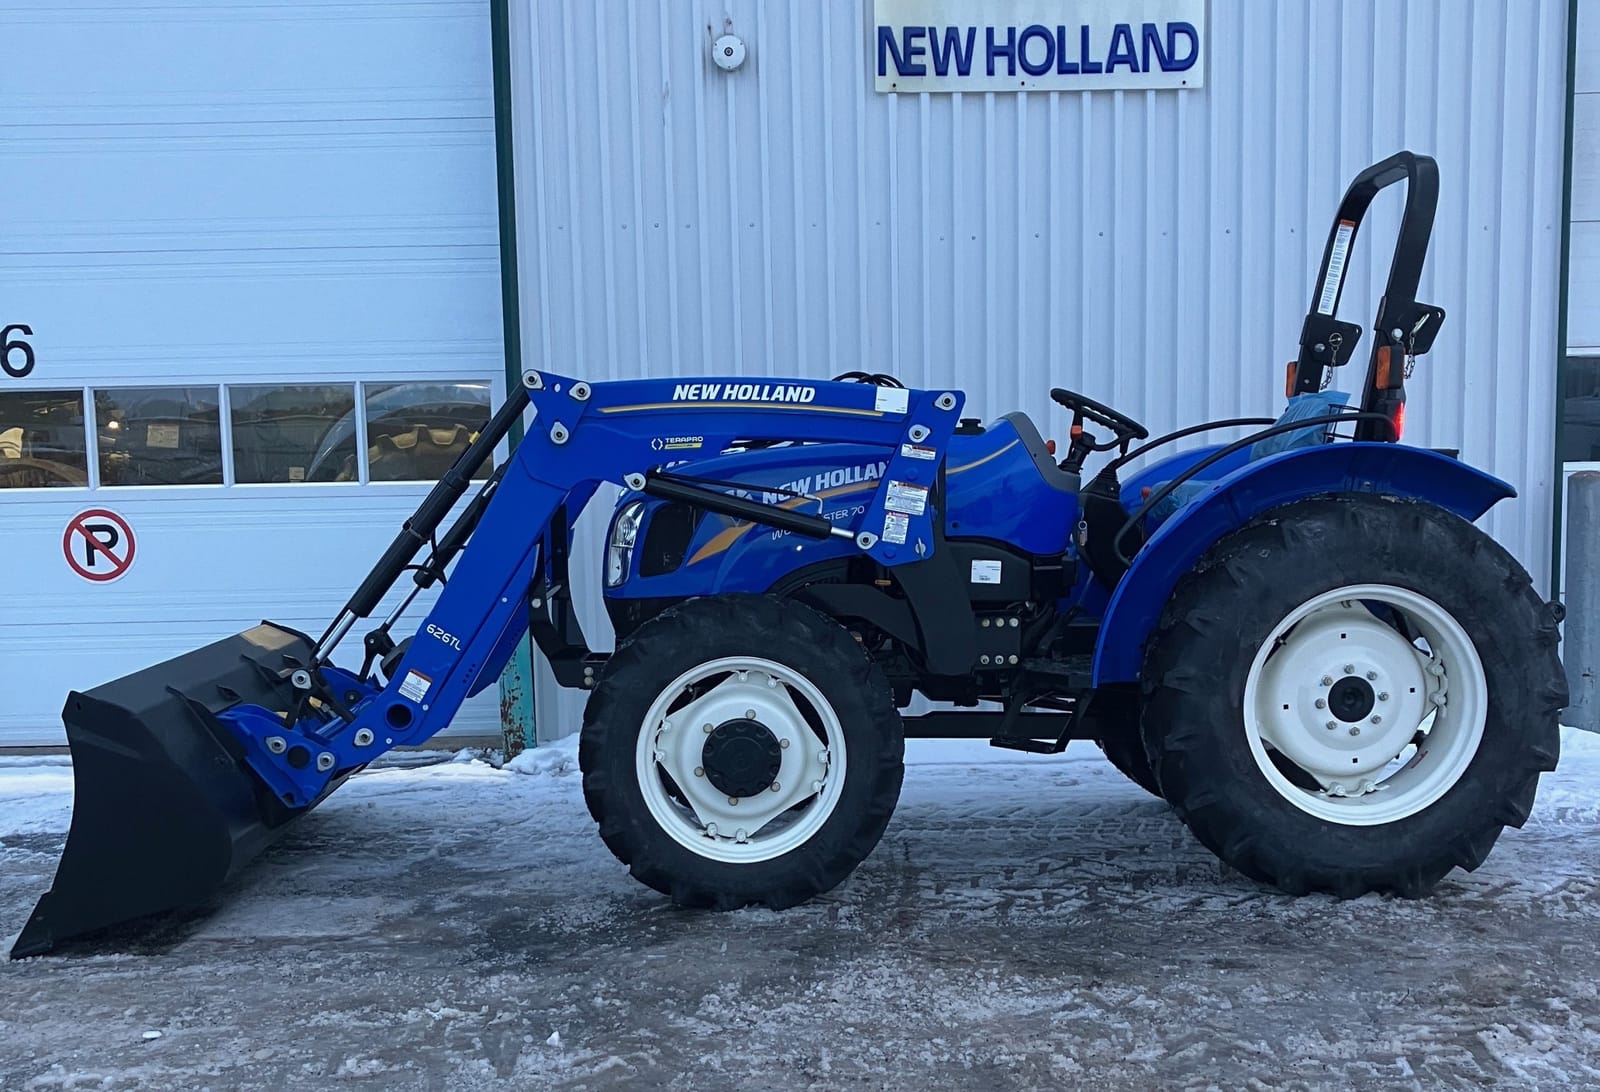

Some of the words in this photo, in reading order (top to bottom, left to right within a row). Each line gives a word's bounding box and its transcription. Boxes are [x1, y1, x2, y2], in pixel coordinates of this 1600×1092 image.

[877, 26, 977, 77] NEW
[985, 22, 1199, 77] HOLLAND
[0, 324, 35, 378] 6
[672, 384, 721, 401] NEW
[722, 384, 816, 403] HOLLAND
[664, 436, 704, 444] TERAPRO
[815, 460, 890, 492] HOLLAN
[851, 505, 865, 516] 70
[84, 524, 119, 566] P
[426, 623, 462, 651] 626TL
